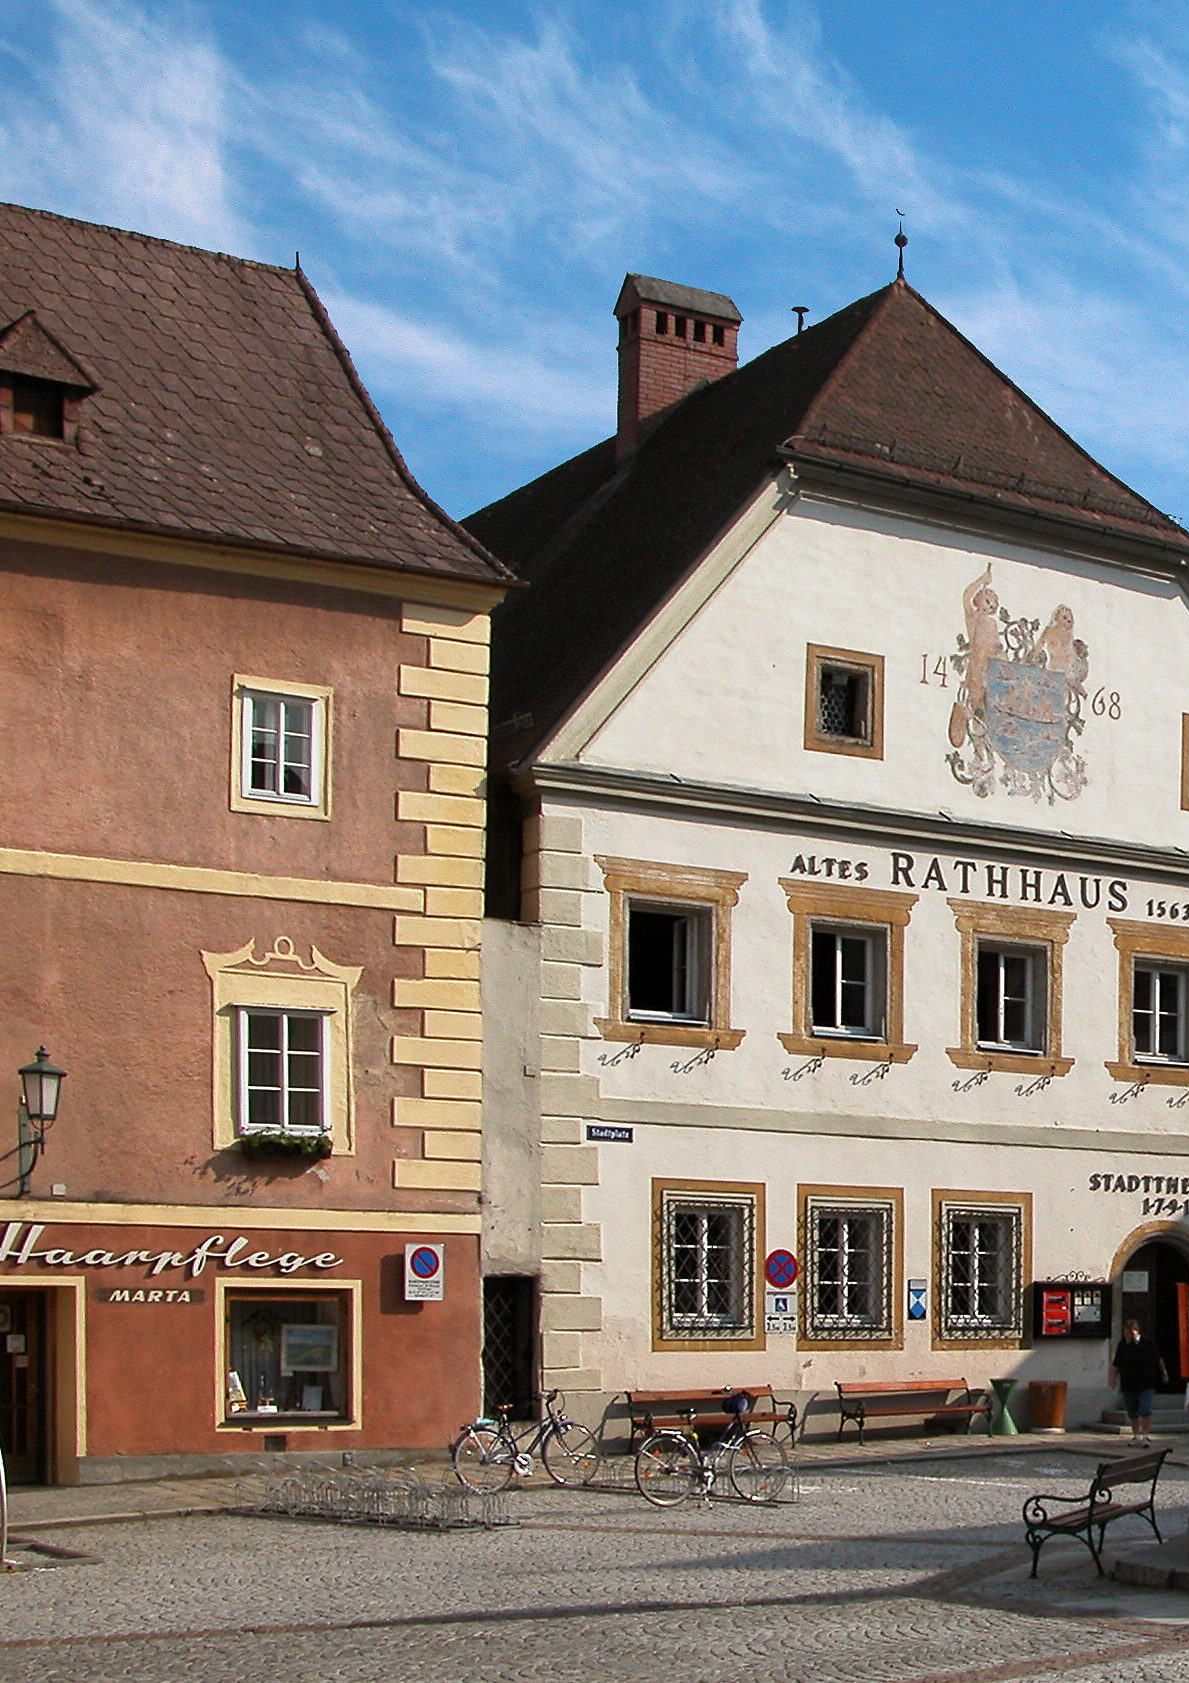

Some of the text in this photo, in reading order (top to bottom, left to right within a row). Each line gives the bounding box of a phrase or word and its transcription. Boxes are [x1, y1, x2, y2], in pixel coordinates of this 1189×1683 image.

[919, 653, 949, 688] 14
[1091, 687, 1122, 720] 68
[790, 854, 869, 881] ALTES
[890, 852, 1129, 913] RATHHAUS
[0, 1222, 344, 1277] Haarpflege
[109, 1289, 191, 1303] MARTA
